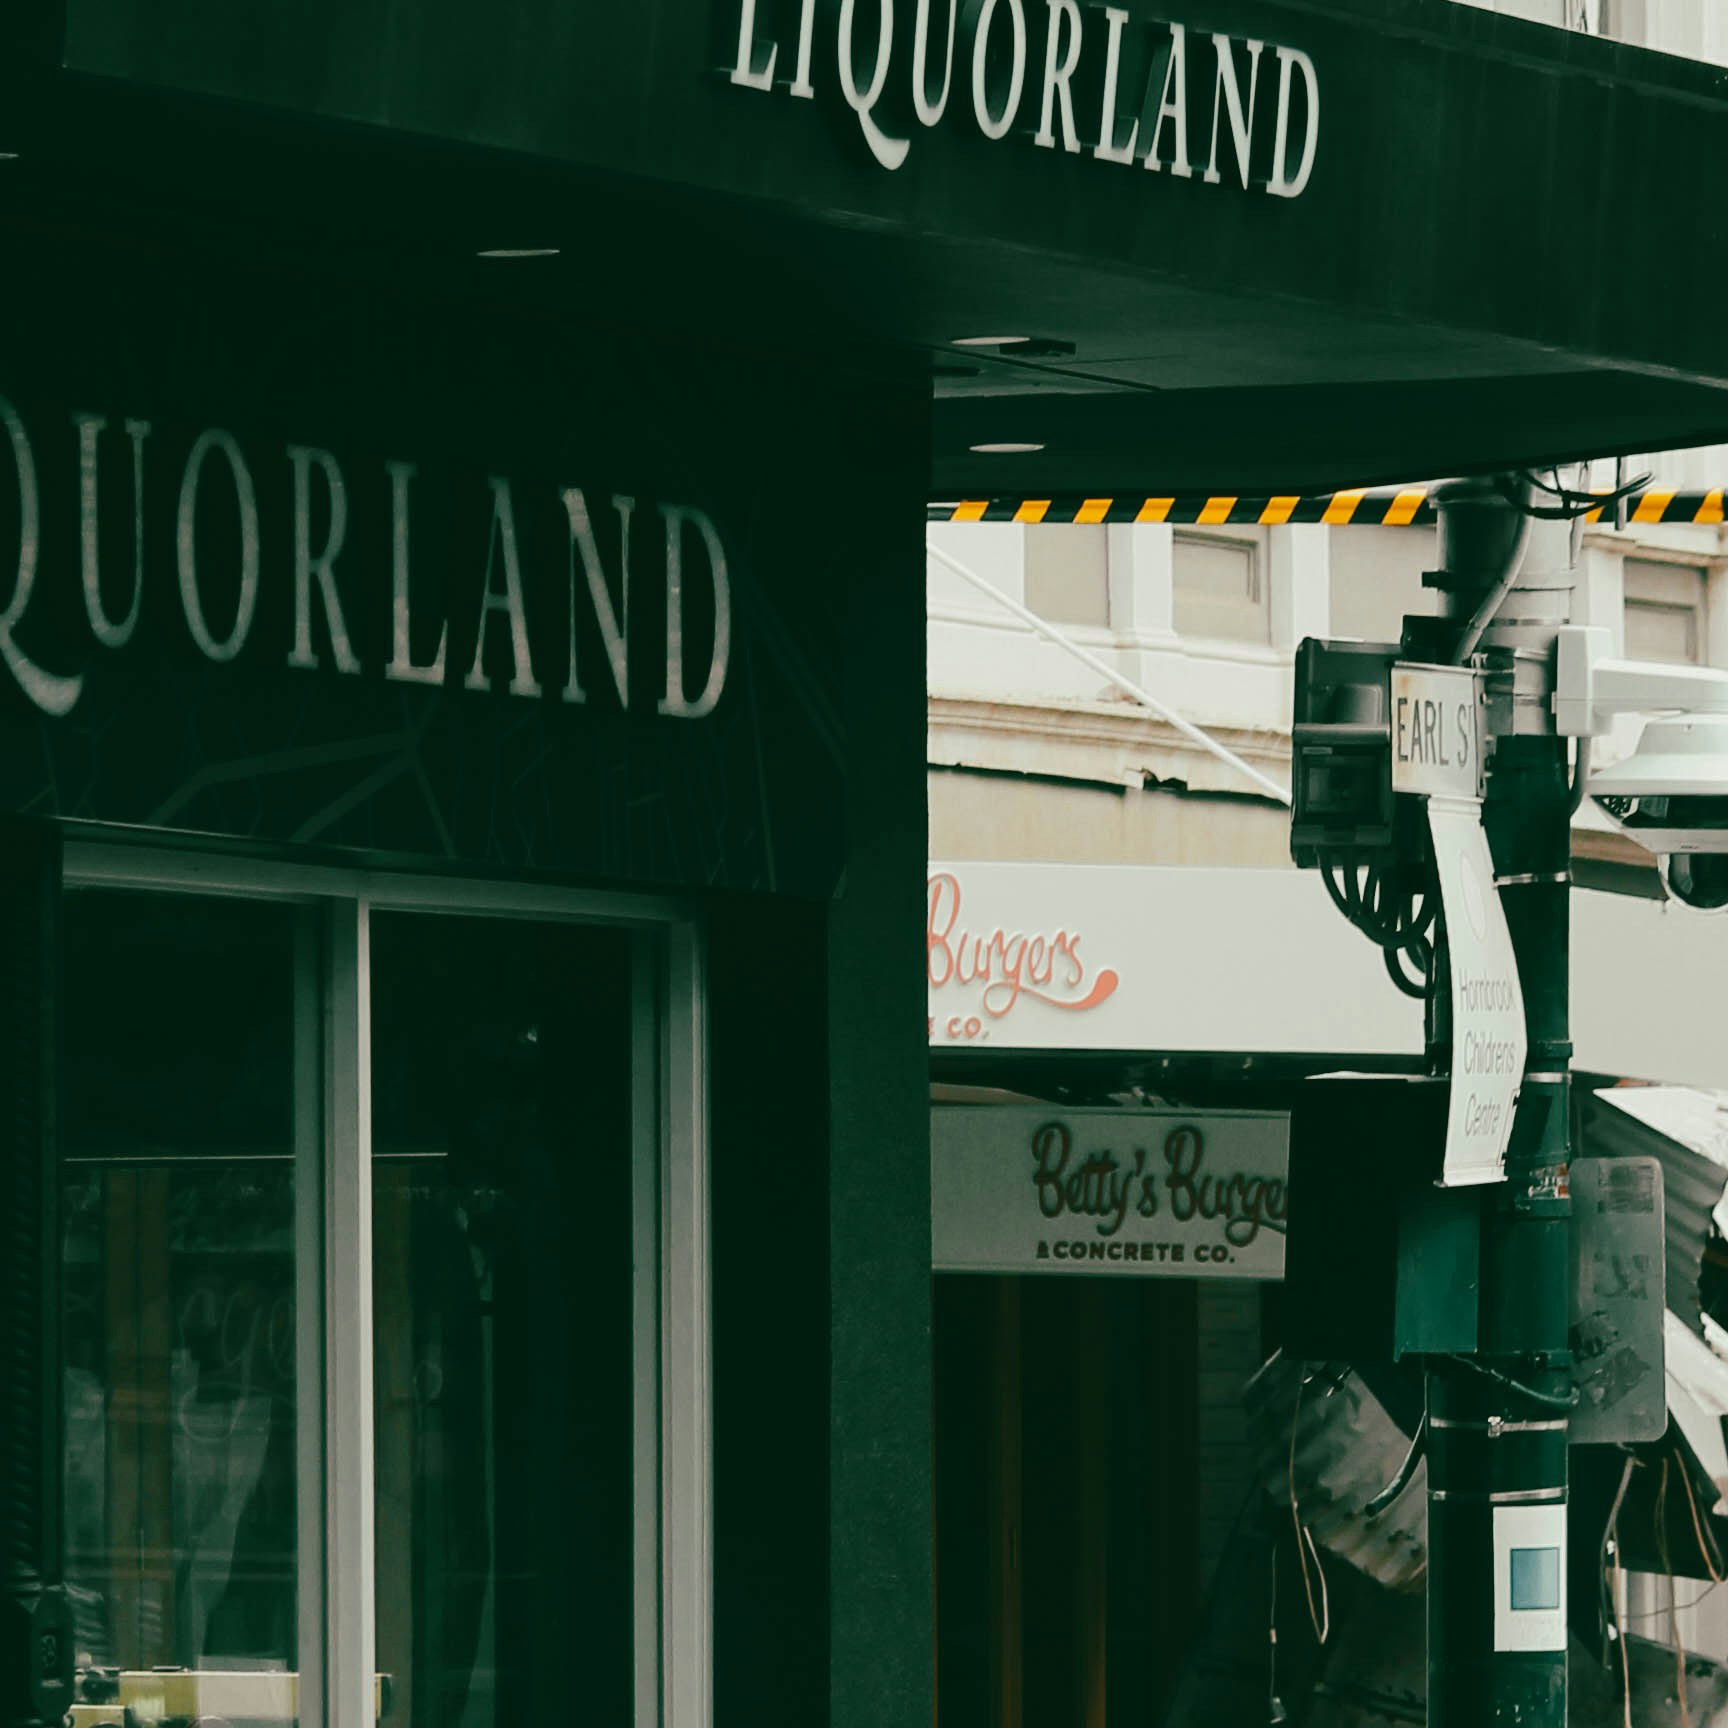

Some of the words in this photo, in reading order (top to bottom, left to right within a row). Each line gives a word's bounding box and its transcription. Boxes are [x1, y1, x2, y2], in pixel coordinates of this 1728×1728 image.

[1396, 697, 1450, 766] EARL
[1456, 702, 1474, 768] ST
[927, 872, 1119, 1018] Burgers
[1458, 968, 1517, 1012] Hornbrook
[1463, 1030, 1516, 1074] Childrens
[1464, 1093, 1502, 1137] Centre
[1032, 1122, 1159, 1236] Betty's
[1194, 1244, 1236, 1264] CO.
